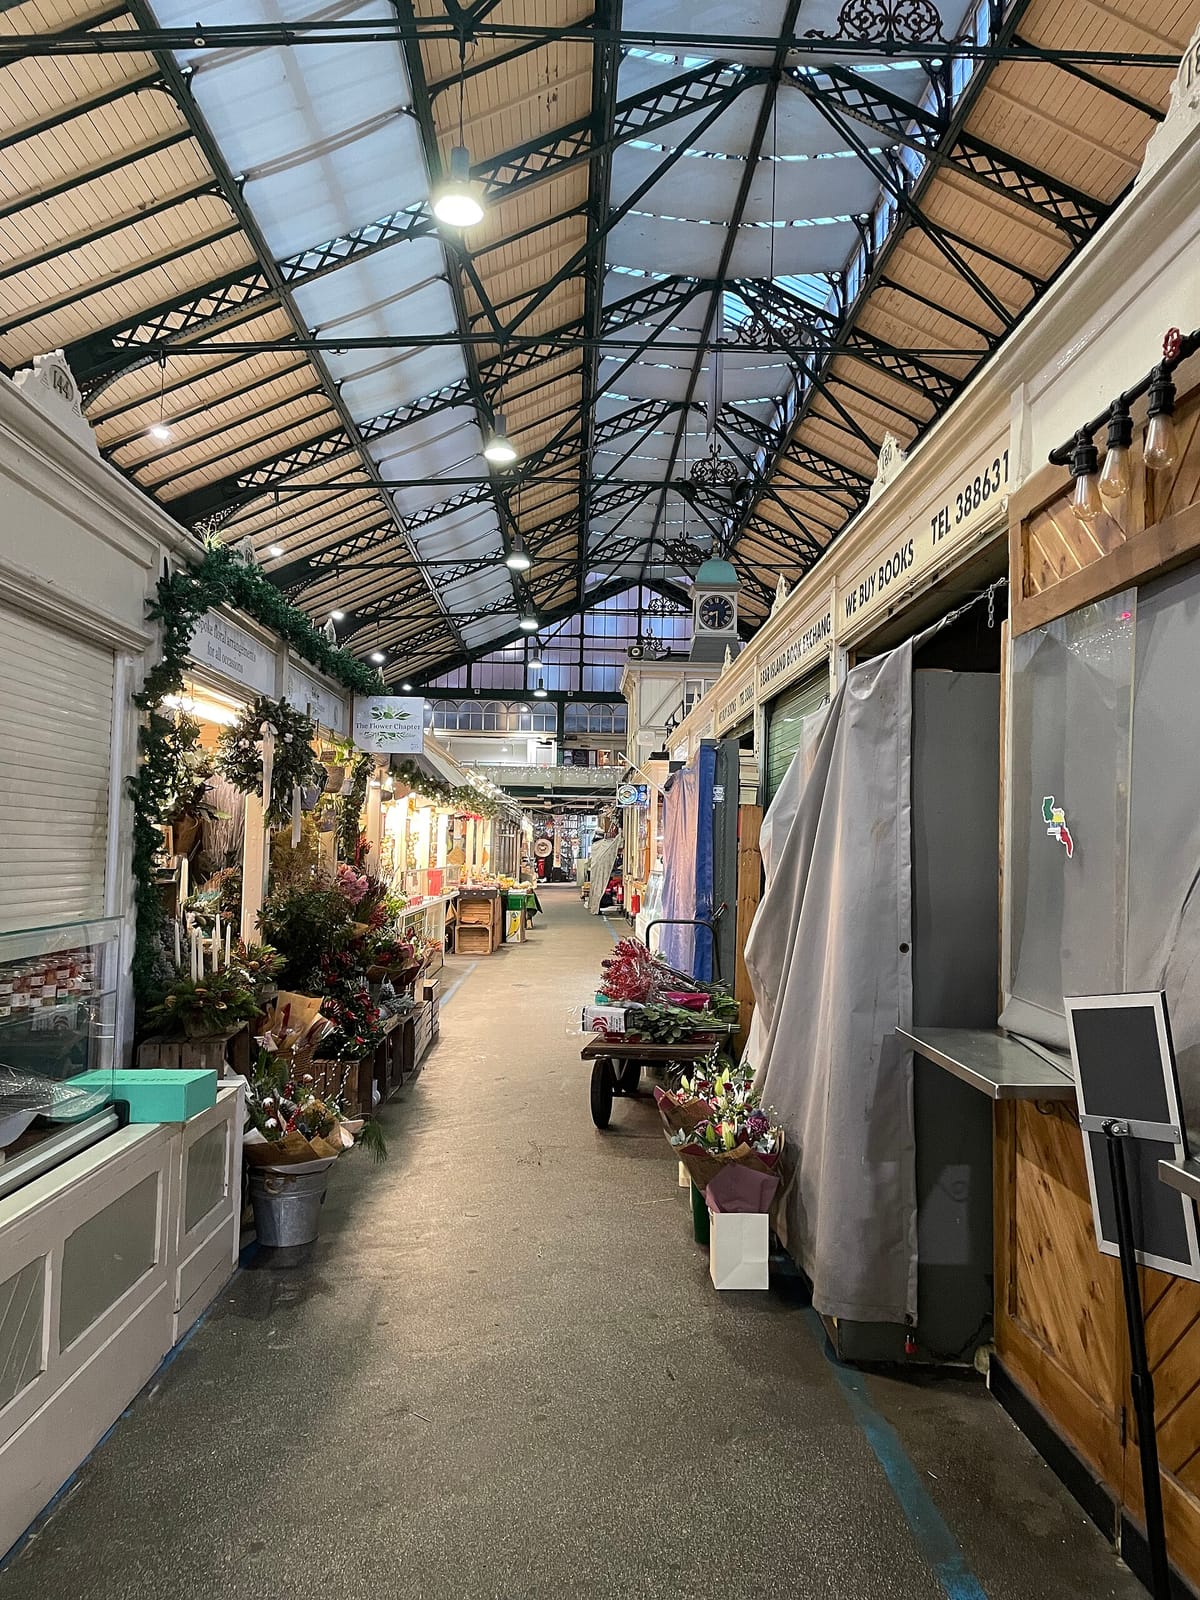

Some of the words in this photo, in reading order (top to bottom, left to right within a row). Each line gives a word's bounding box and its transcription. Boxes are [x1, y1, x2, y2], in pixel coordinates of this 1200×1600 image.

[53, 370, 69, 399] 144
[845, 590, 857, 618] WE
[859, 571, 876, 608] BUY
[878, 538, 914, 592] BOOKS
[930, 505, 952, 545] TEL
[955, 449, 1009, 524] 388631
[802, 613, 831, 653] EXCHANG
[393, 722, 420, 731] Chapter
